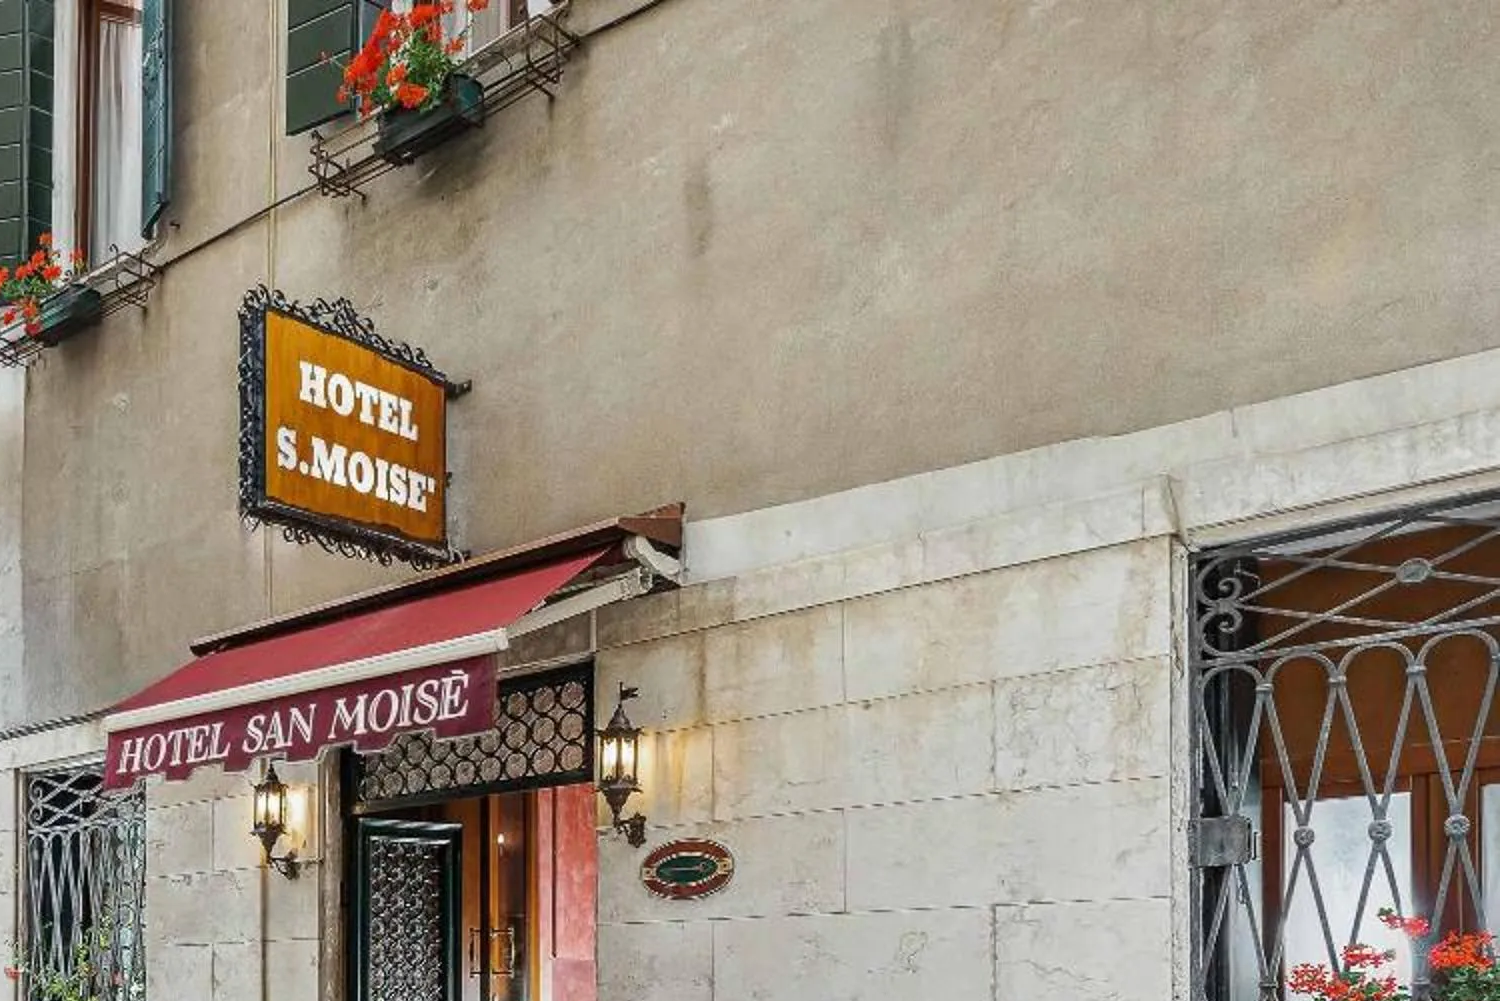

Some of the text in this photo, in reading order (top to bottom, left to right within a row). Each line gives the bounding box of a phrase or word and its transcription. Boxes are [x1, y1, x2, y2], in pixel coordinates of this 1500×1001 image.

[299, 360, 418, 440] HOTEL
[116, 722, 231, 774] HOTEL
[242, 703, 317, 754] SAN
